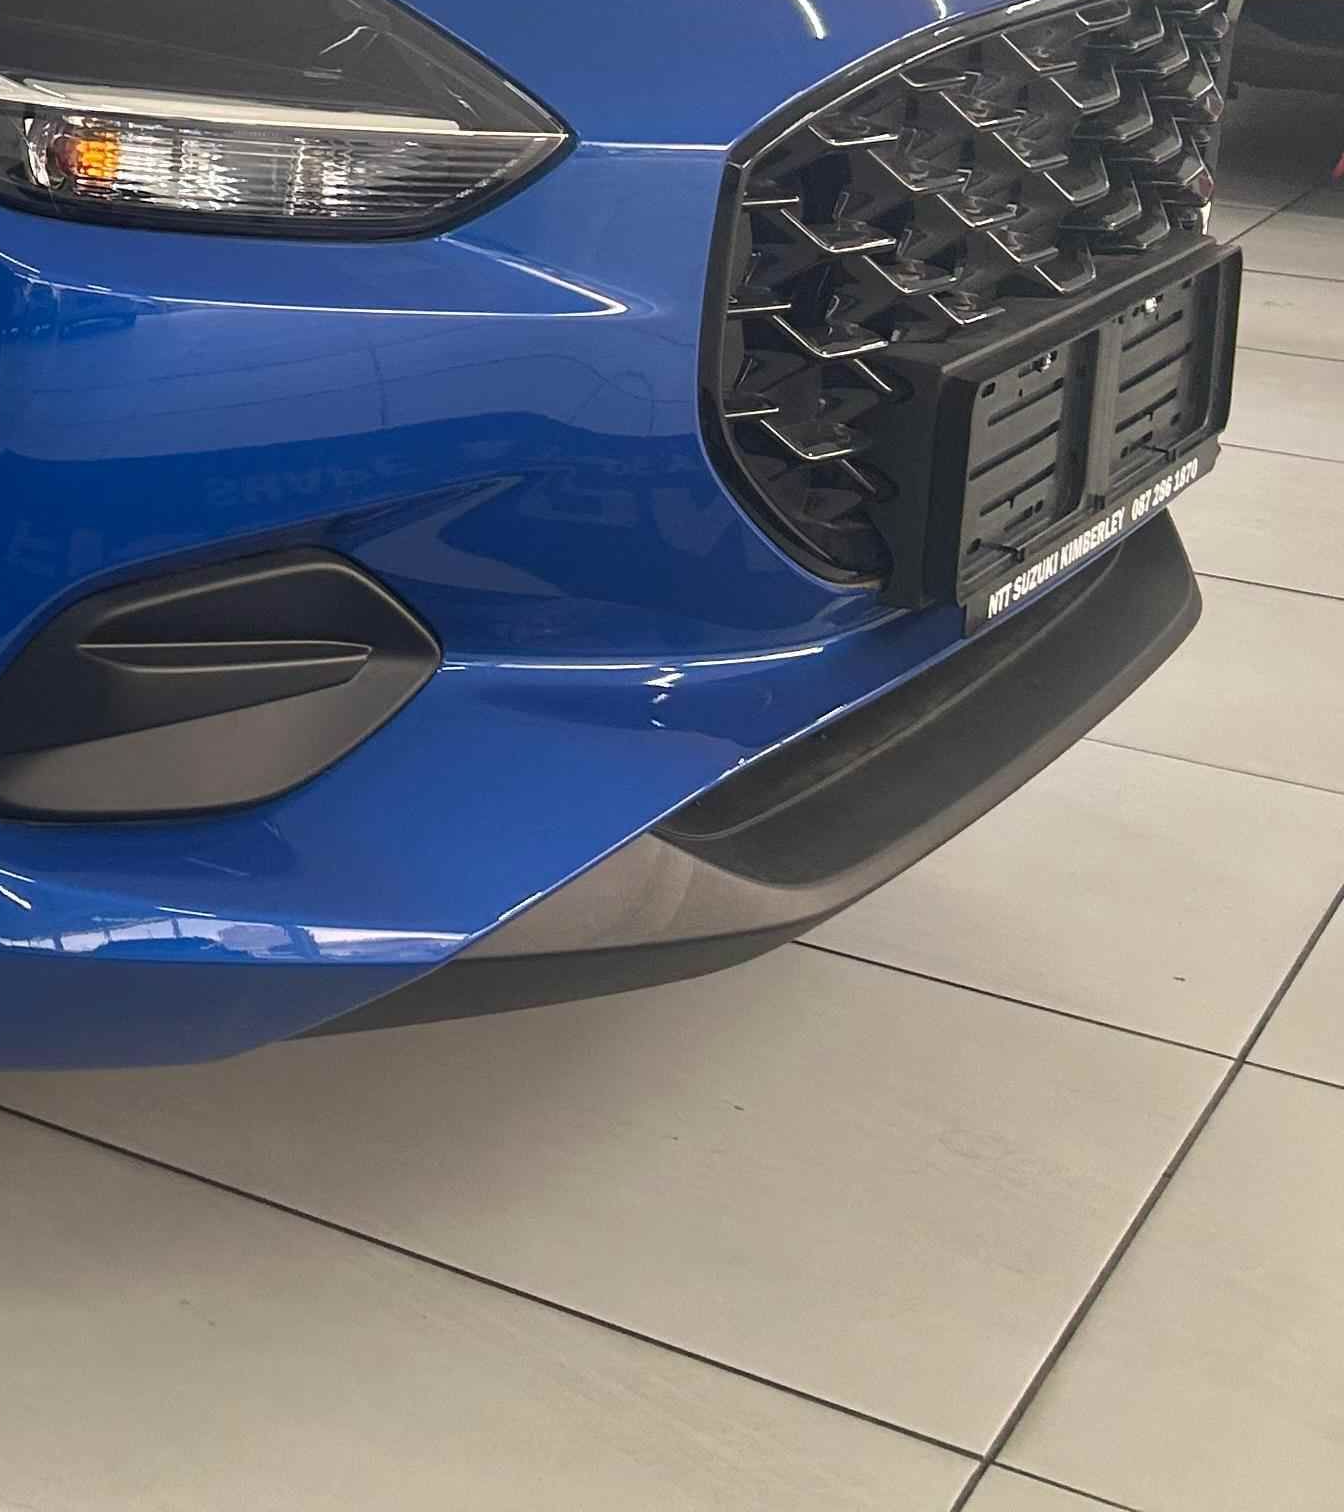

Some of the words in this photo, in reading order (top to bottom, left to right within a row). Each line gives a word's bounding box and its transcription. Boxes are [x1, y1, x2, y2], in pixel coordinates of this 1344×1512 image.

[987, 582, 1013, 619] NTT
[1011, 550, 1059, 601] SUZUKI
[1059, 506, 1126, 569] KIMBERLEY
